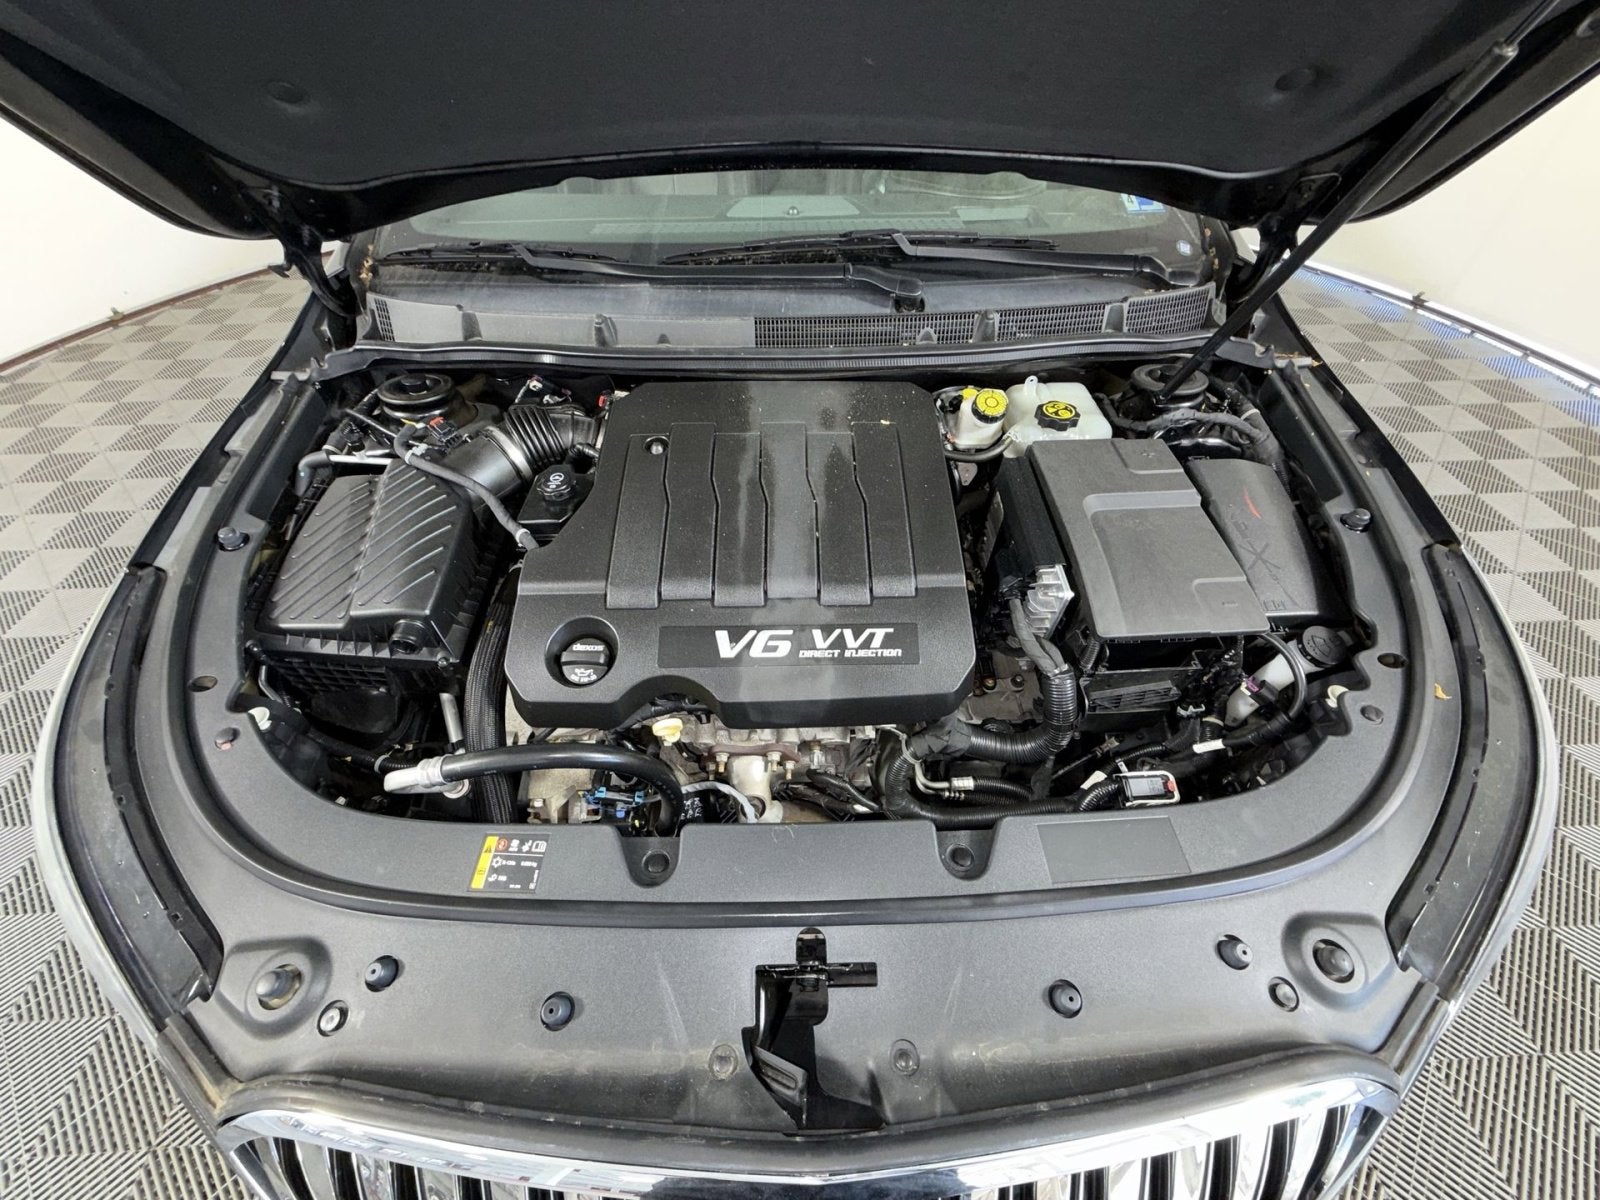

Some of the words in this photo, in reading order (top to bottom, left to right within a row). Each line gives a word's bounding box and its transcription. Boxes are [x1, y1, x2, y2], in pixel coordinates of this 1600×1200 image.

[715, 629, 794, 659] V6
[811, 628, 895, 649] VVT
[573, 643, 604, 651] dexos
[799, 649, 841, 658] DIRECT
[844, 648, 902, 658] INJECTION
